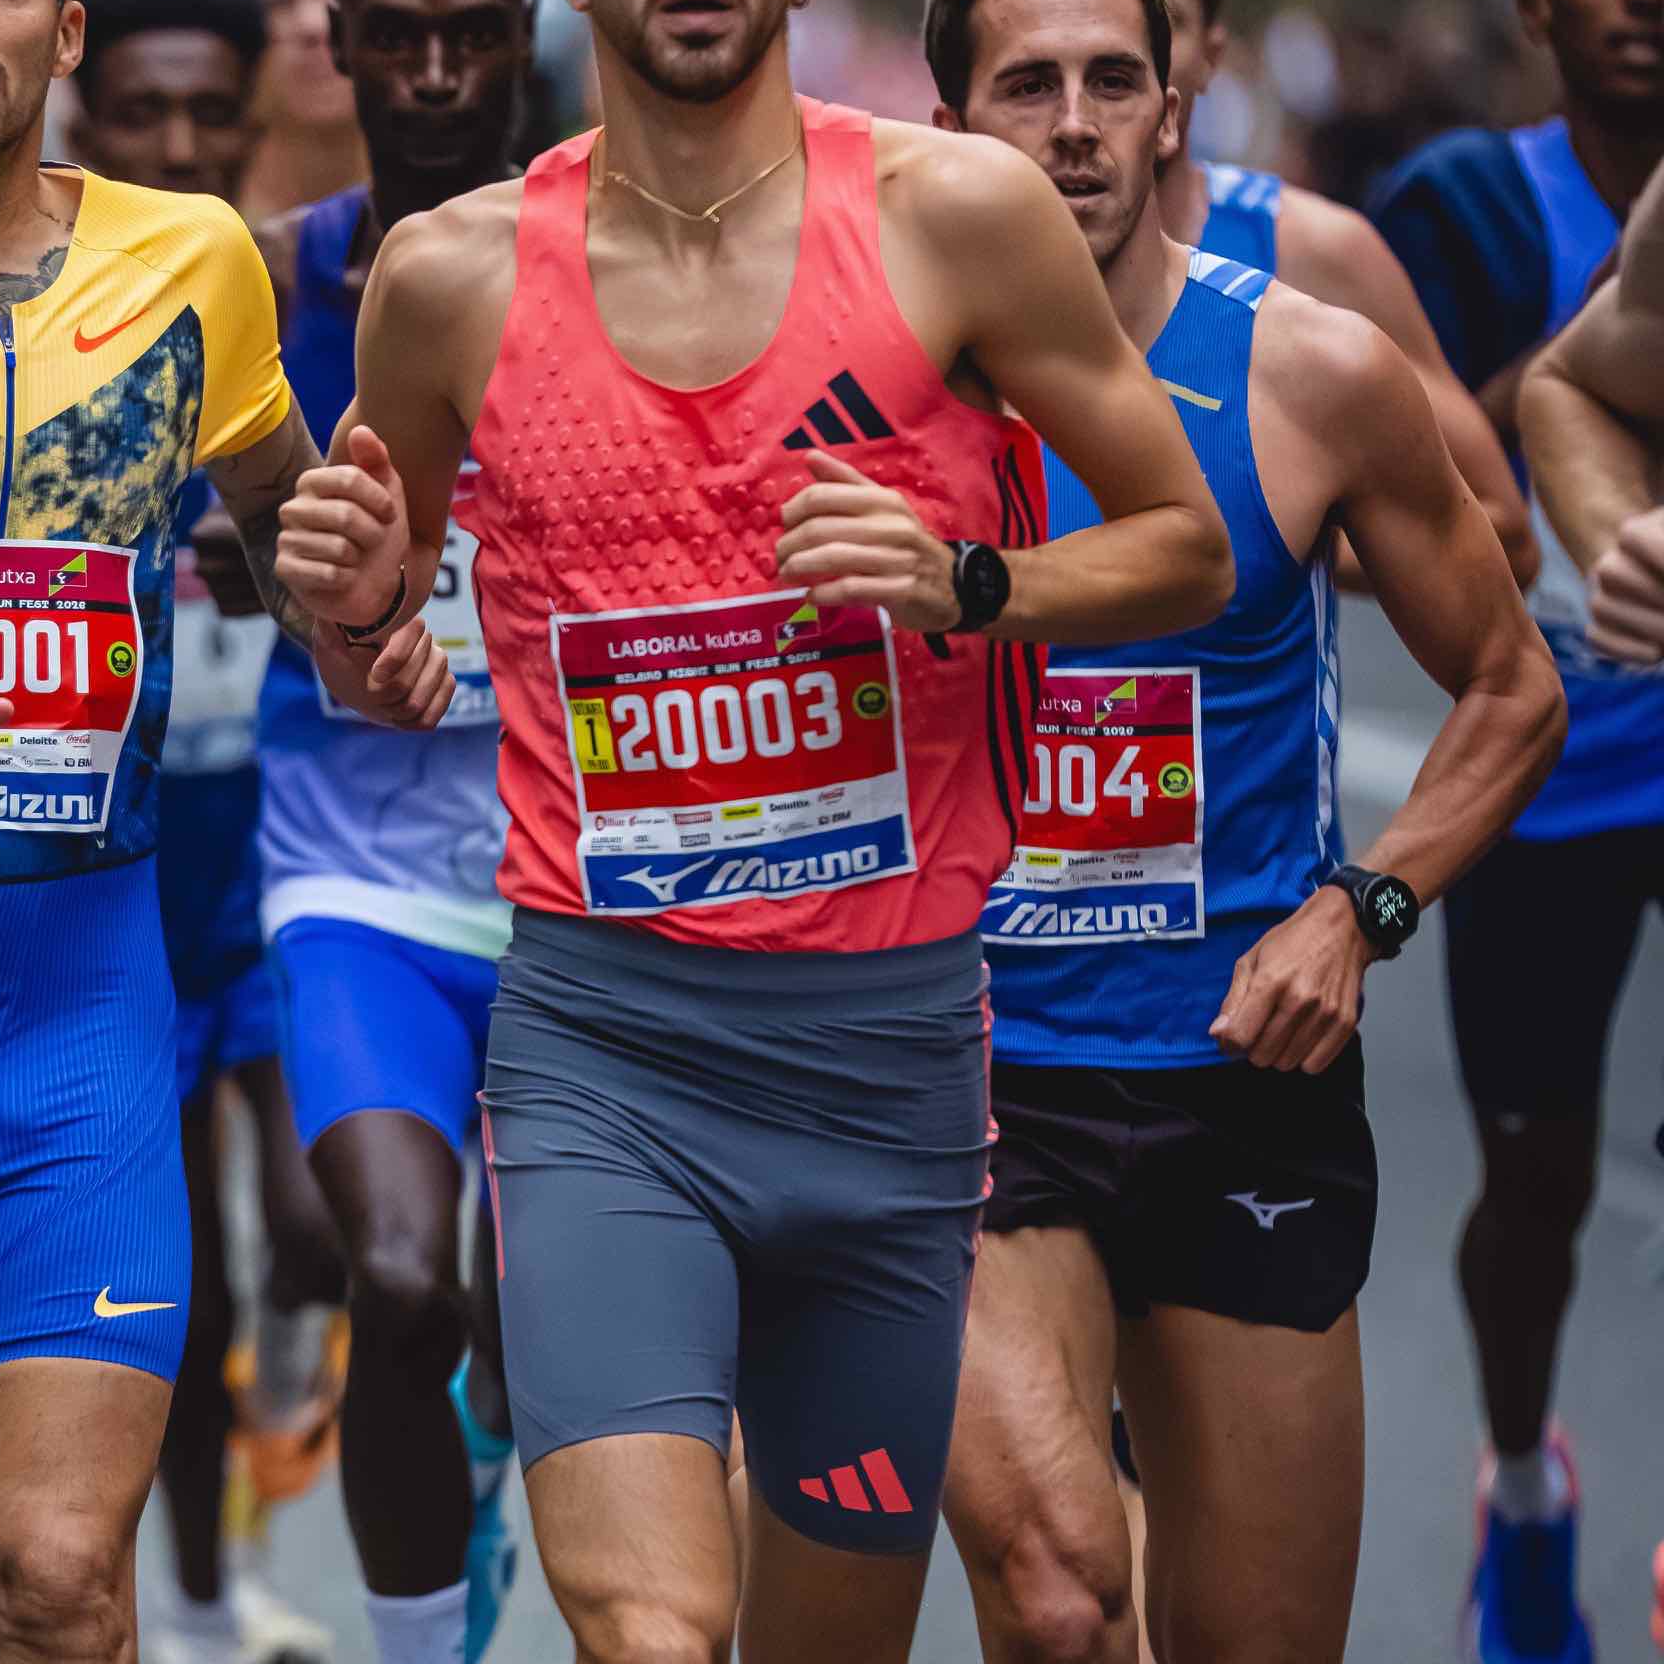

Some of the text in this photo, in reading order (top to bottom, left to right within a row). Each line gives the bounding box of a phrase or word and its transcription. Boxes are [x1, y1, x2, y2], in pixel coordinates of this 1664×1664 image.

[19, 599, 50, 610] FEST
[607, 628, 763, 659] LABORAL kutxa
[1038, 696, 1083, 713] utxa
[611, 670, 843, 773] 20003
[19, 735, 58, 746] Deloitte
[585, 717, 599, 757] 1
